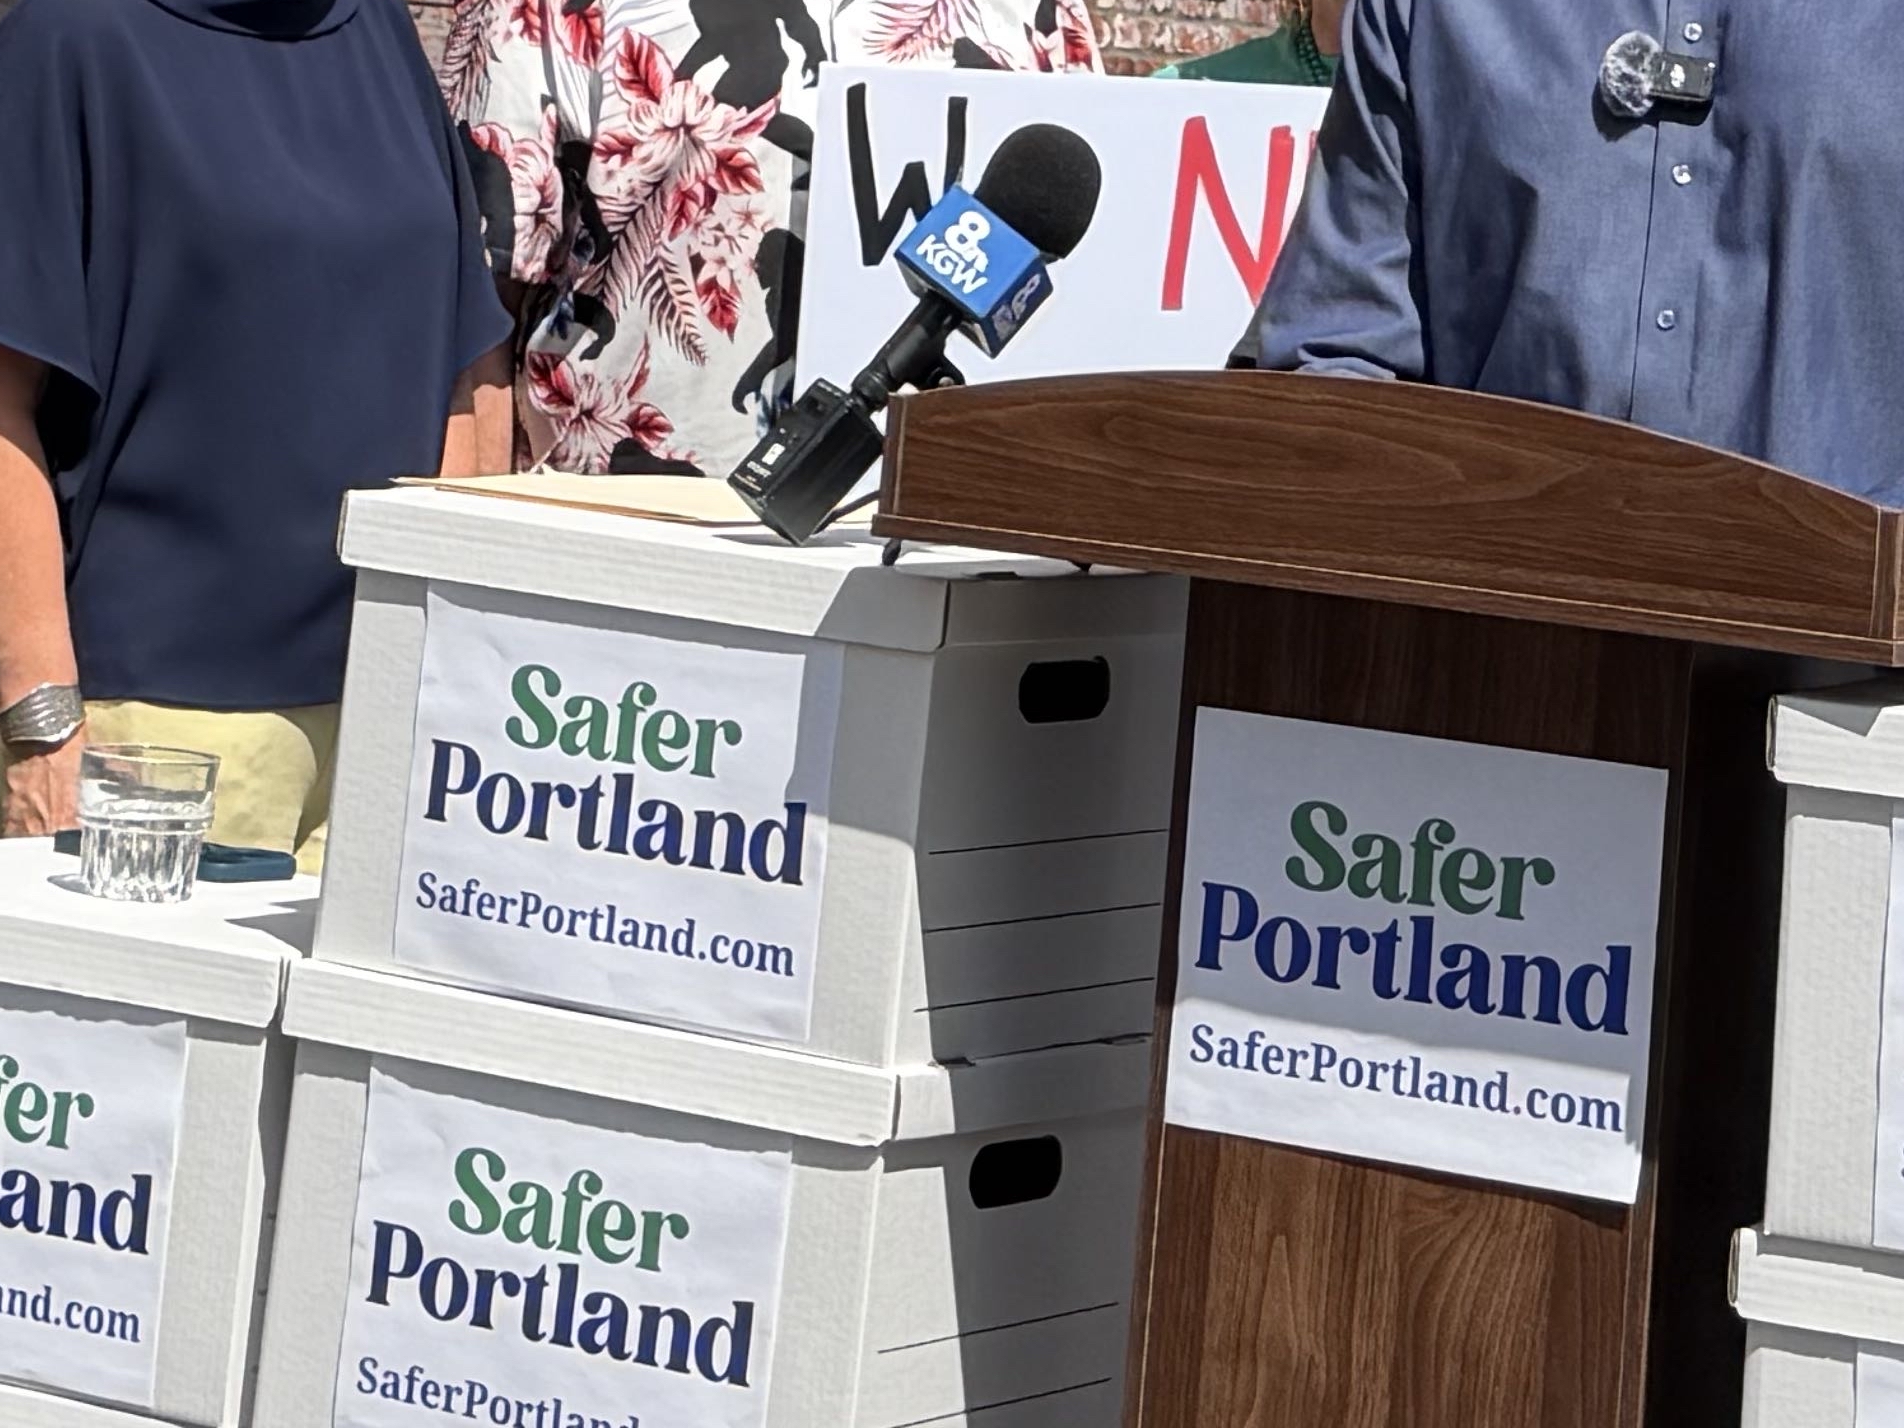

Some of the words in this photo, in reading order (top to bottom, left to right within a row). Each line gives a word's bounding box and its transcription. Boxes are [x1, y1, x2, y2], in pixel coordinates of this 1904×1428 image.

[916, 234, 988, 294] KGW
[1161, 115, 1320, 311] N
[505, 663, 743, 779] Safer
[423, 738, 807, 888] Portland
[1285, 800, 1556, 921] Safer
[415, 870, 795, 977] SaferPortland.com
[1195, 881, 1633, 1037] Portland
[1189, 1024, 1623, 1133] SaferPortland.com
[448, 1147, 690, 1272] Safer
[365, 1219, 756, 1388] Portland
